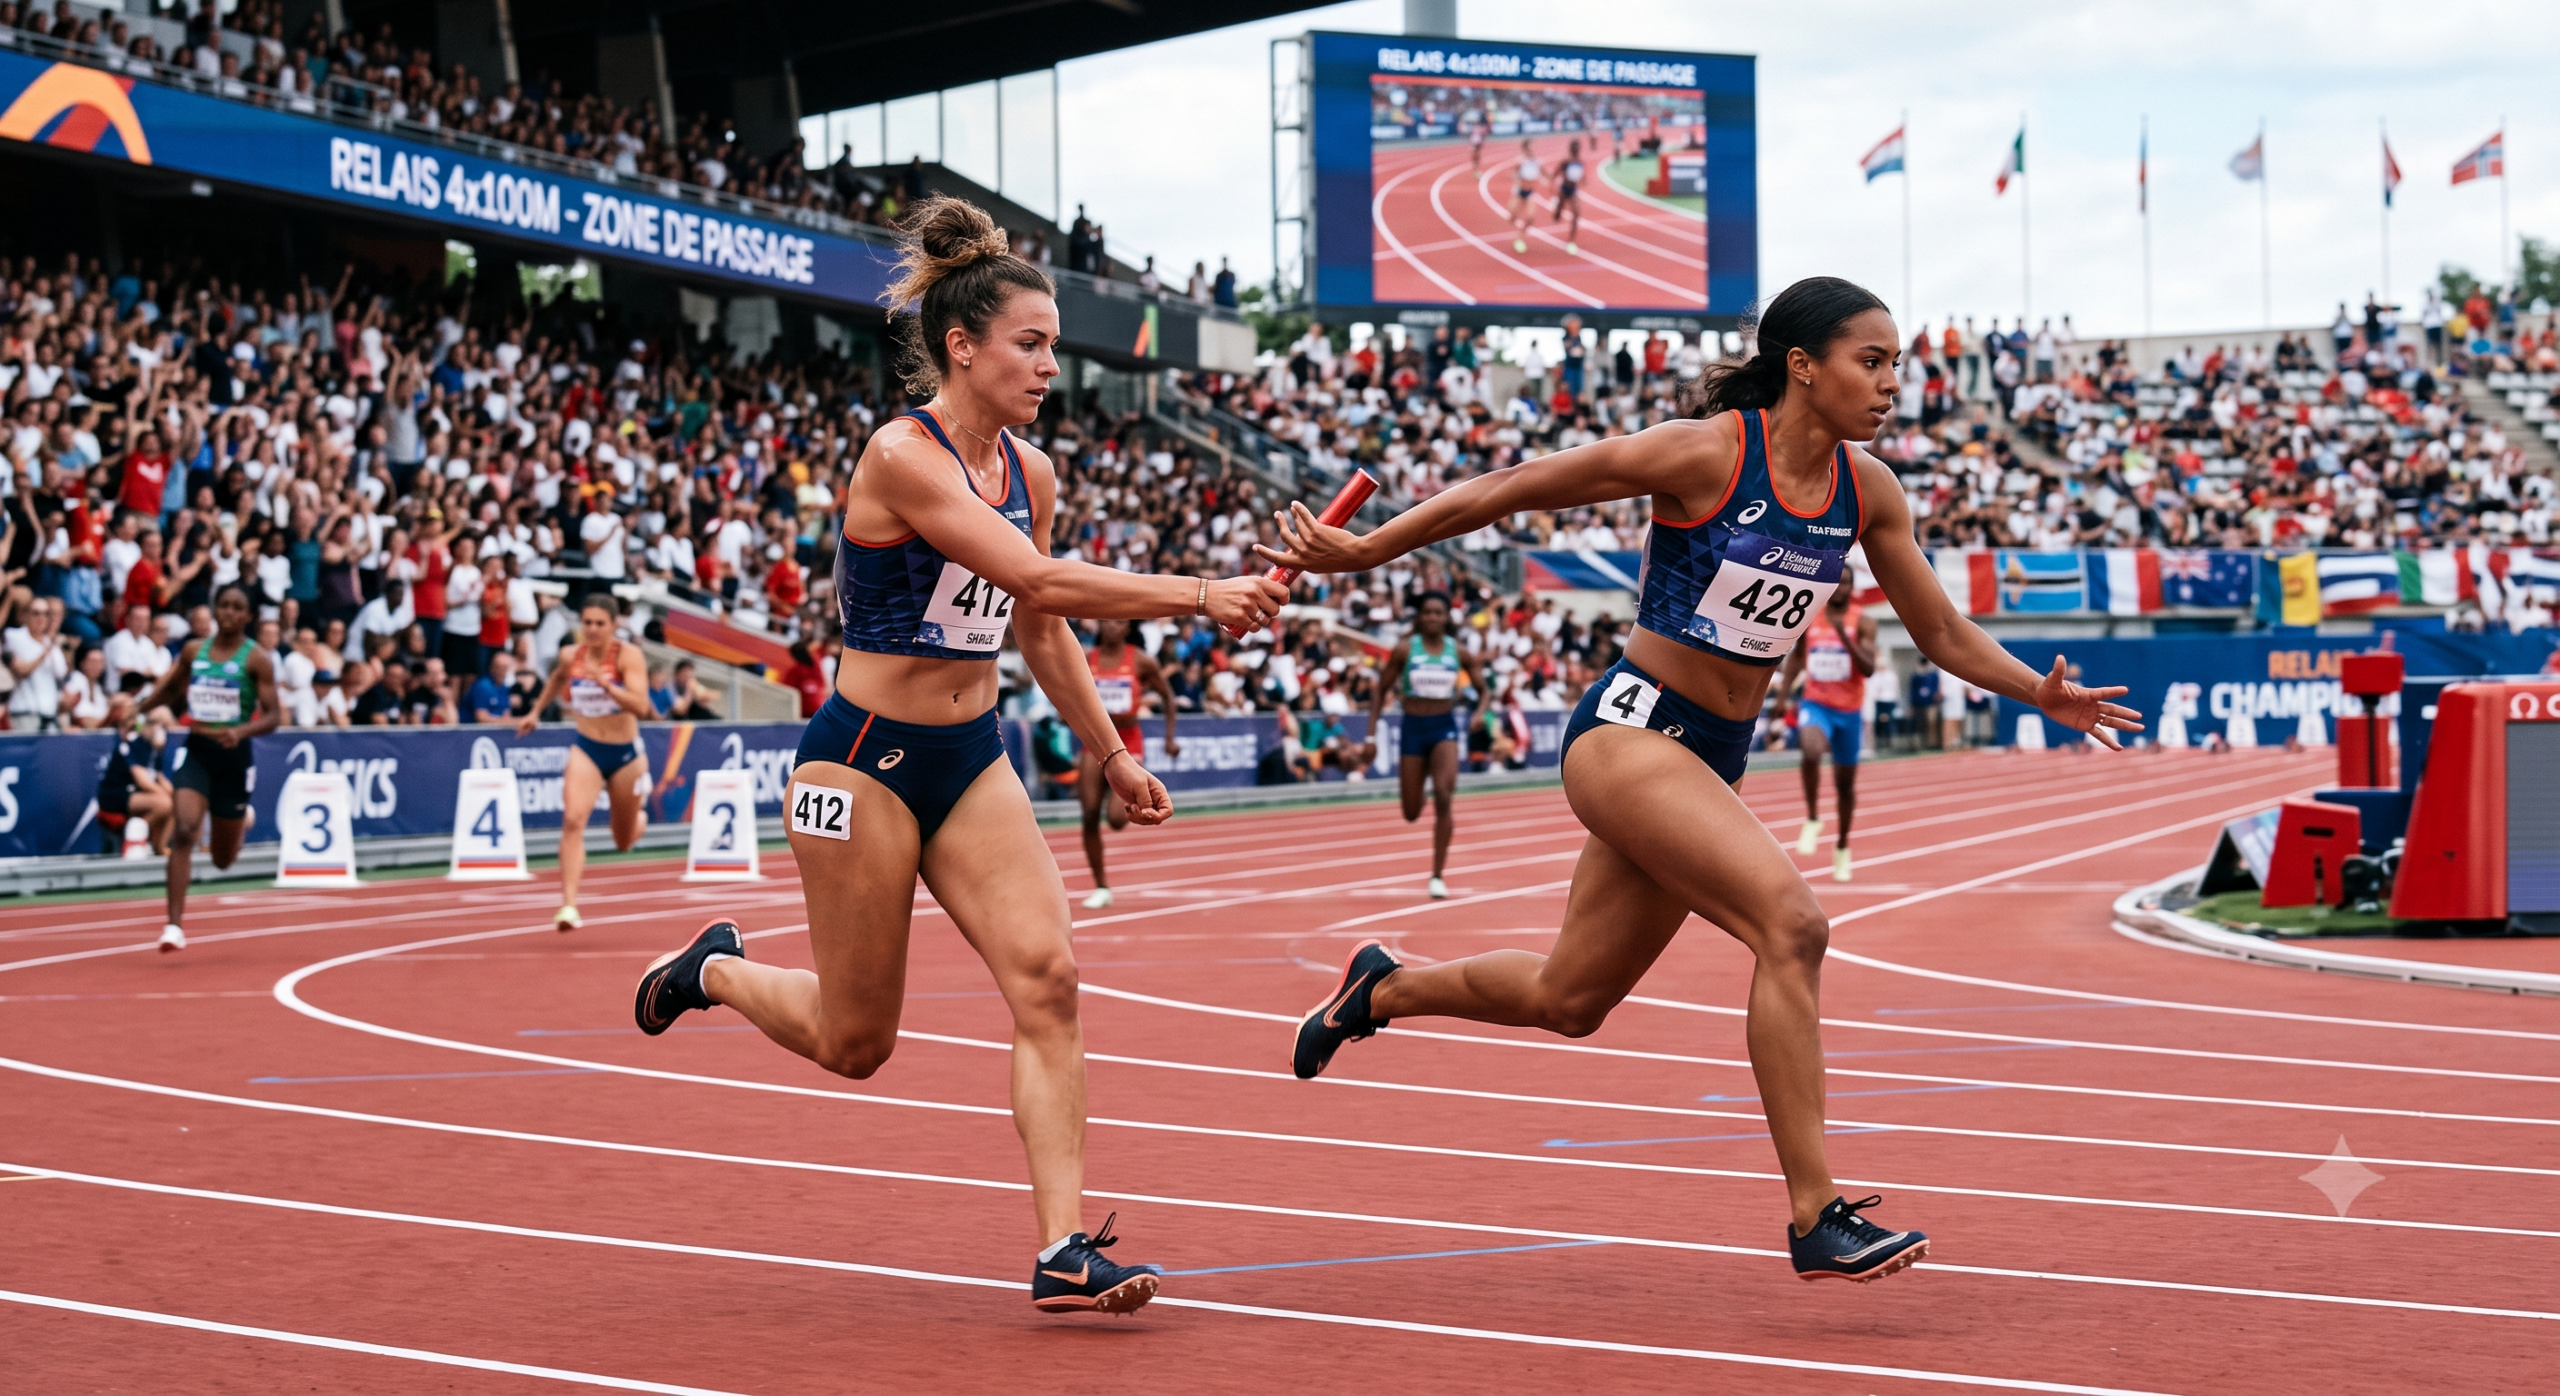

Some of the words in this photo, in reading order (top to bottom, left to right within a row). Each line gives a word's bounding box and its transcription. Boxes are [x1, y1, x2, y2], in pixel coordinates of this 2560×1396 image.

[1378, 48, 1446, 74] RELAIS
[1532, 56, 1586, 81] ZONE
[1586, 59, 1614, 82] DE
[1614, 60, 1697, 87] PASSAGE
[330, 136, 441, 210] RELAIS
[443, 164, 561, 234] 4x100M
[582, 191, 661, 255] ZONE
[662, 208, 701, 262] DE
[702, 217, 815, 285] PASSAGE
[951, 574, 1012, 618] 412
[1728, 578, 1814, 629] 428
[2268, 650, 2357, 680] RELAI
[1611, 683, 1642, 719] 4
[302, 804, 333, 853] 3
[471, 799, 504, 847] 4
[710, 802, 735, 850] 2
[795, 791, 844, 832] 412
